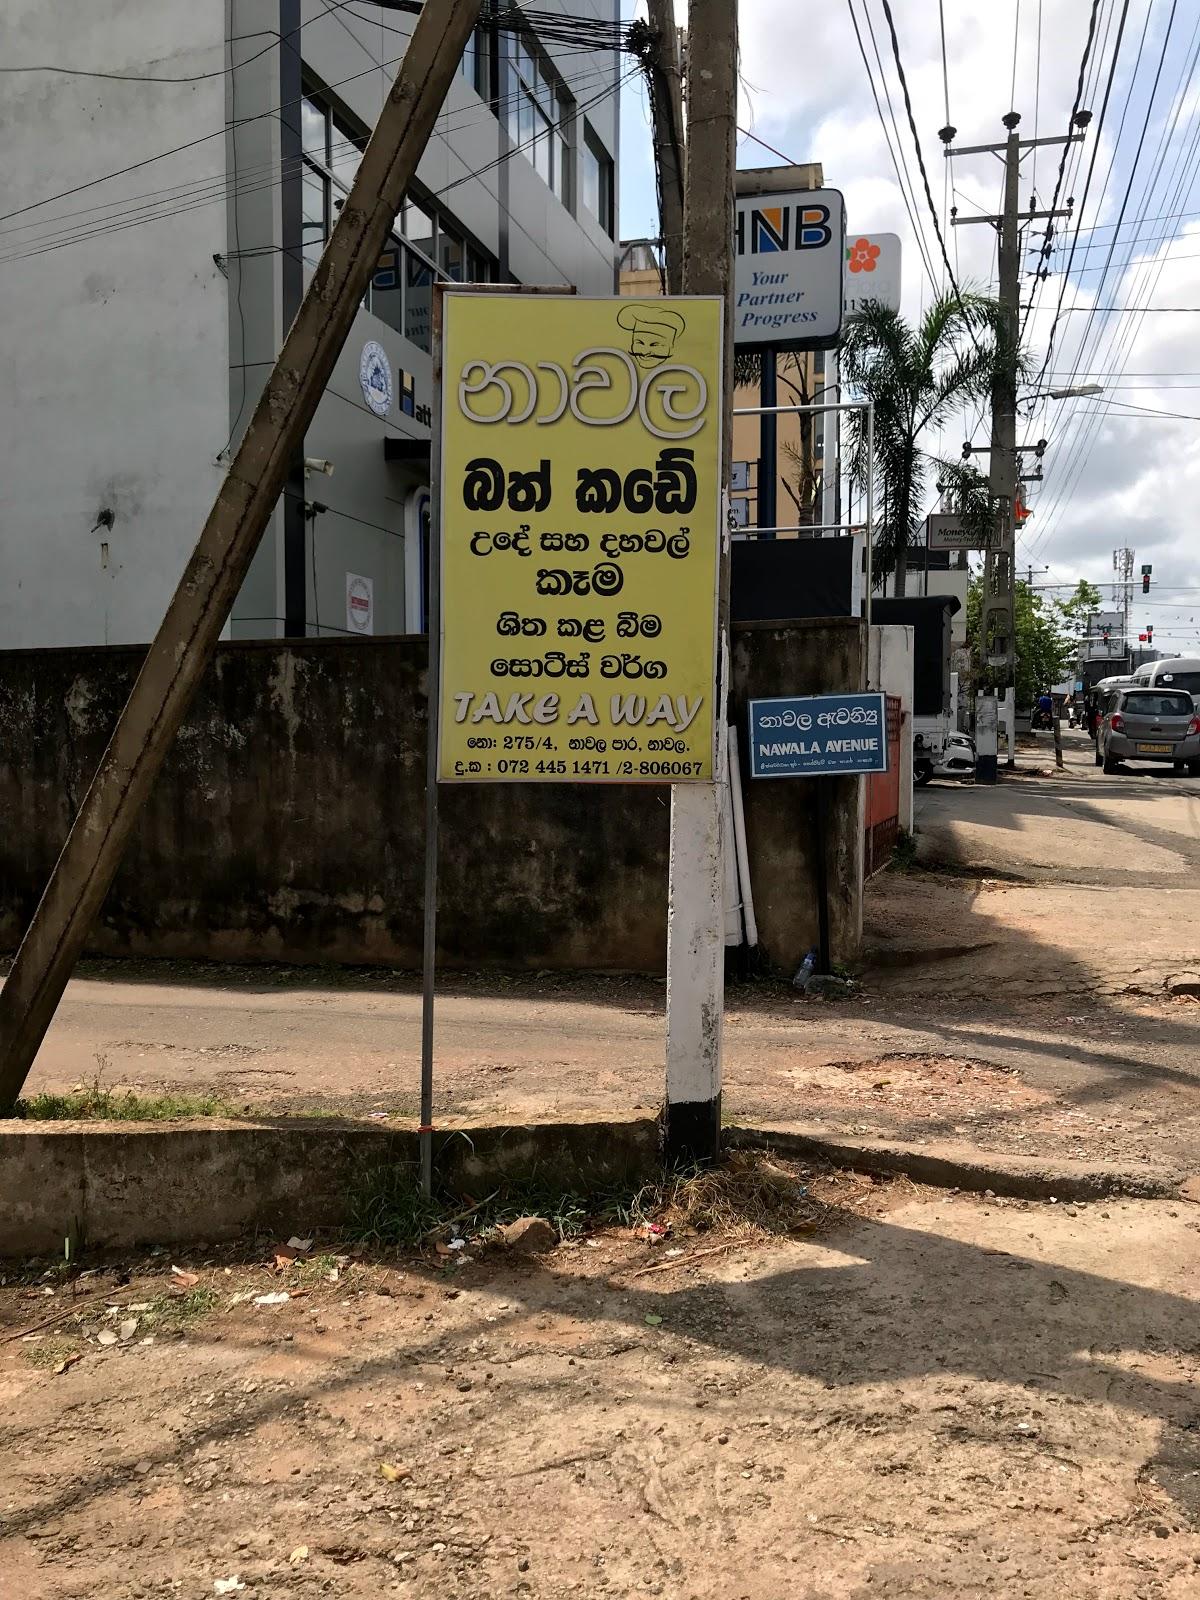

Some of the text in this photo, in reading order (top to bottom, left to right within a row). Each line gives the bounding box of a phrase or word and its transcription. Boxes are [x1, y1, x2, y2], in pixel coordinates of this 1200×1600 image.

[736, 204, 832, 255] NB
[752, 272, 789, 286] Your
[737, 291, 805, 307] Partner
[741, 311, 818, 328] Progress
[458, 346, 710, 440] නාවල
[463, 448, 697, 514] බත් කඩේ
[470, 525, 690, 559] උදේ සහ දහවල්
[536, 562, 623, 596] කෑම
[557, 619, 606, 643] කළ
[617, 612, 662, 638] බීම
[600, 654, 667, 679] වර්ග
[454, 692, 704, 733] TAKE A WAY
[759, 710, 812, 730] නාවල
[504, 736, 557, 751] 275/4,
[569, 736, 606, 753] නාවල
[612, 737, 642, 752] පාර,
[648, 737, 689, 753] නාවල.
[760, 738, 878, 756] NAWALA AVENUE
[498, 760, 529, 773] 072
[535, 760, 566, 773] 445
[573, 761, 609, 774] 1471
[616, 761, 703, 776] /2-806067
